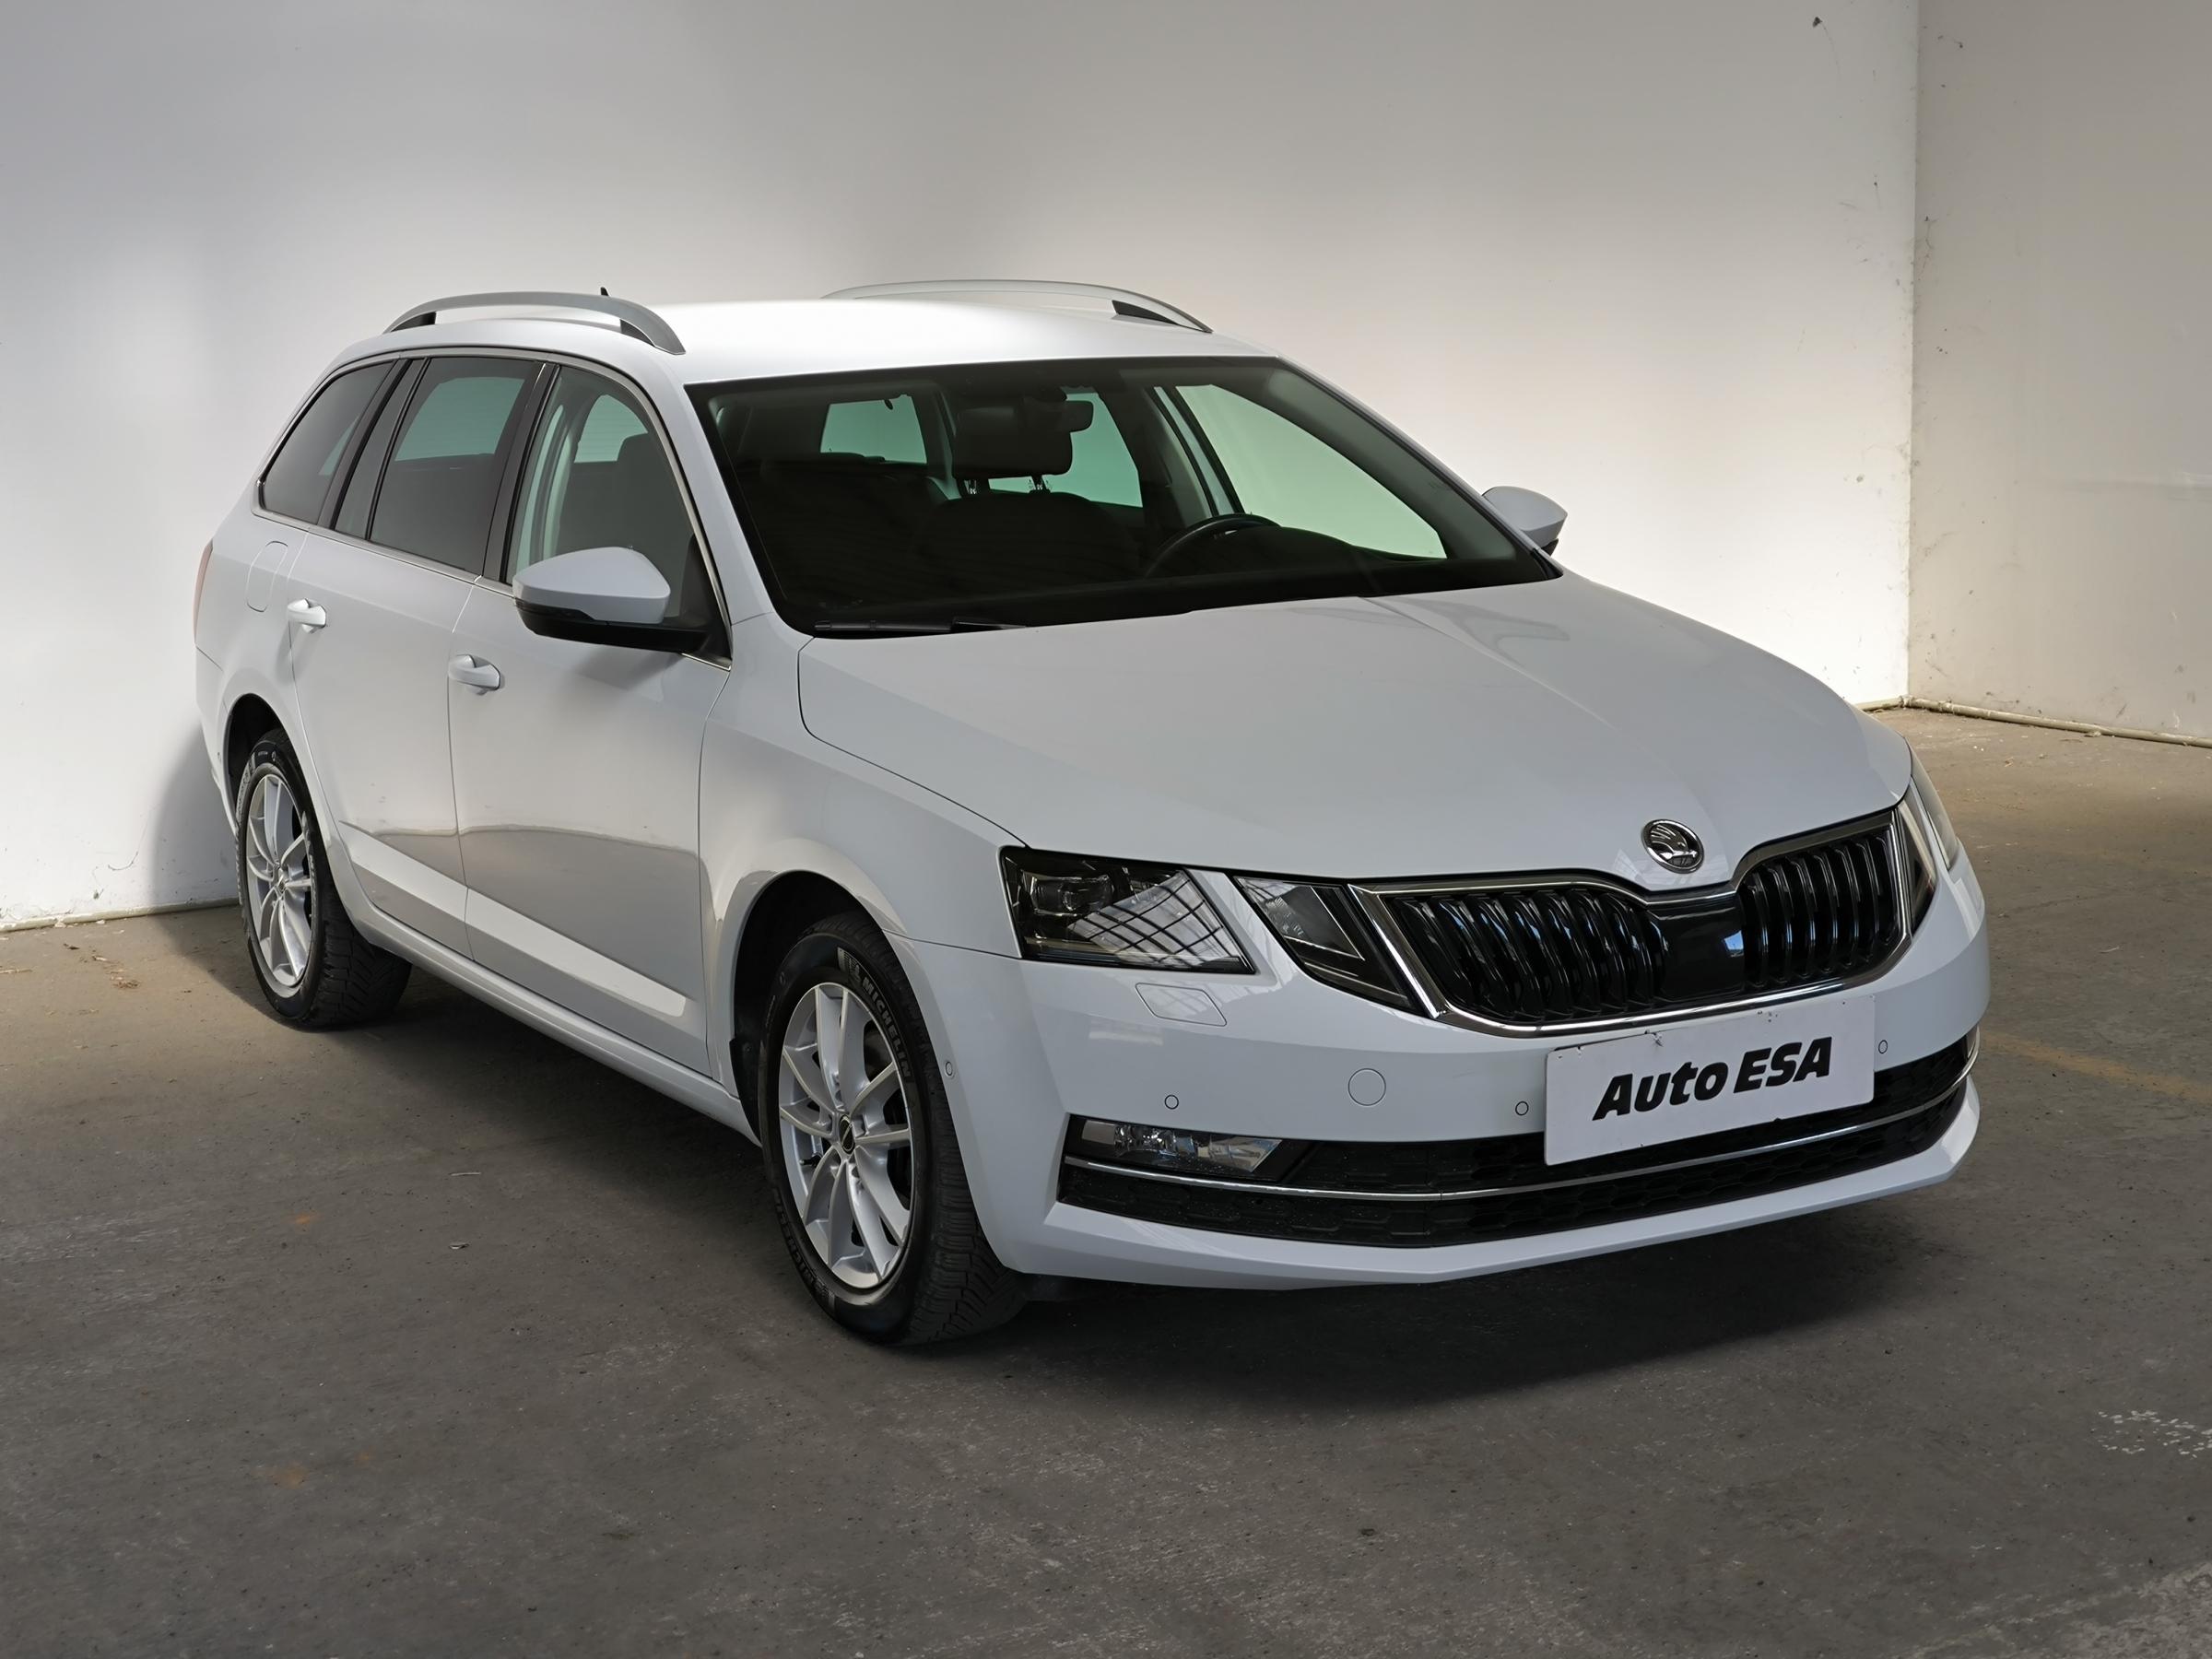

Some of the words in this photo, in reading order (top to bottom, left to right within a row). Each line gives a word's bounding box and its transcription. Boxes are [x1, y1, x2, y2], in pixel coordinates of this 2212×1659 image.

[861, 976, 912, 1078] MICHELIN
[1592, 1061, 1729, 1122] Auto
[1733, 1036, 1833, 1094] ESA
